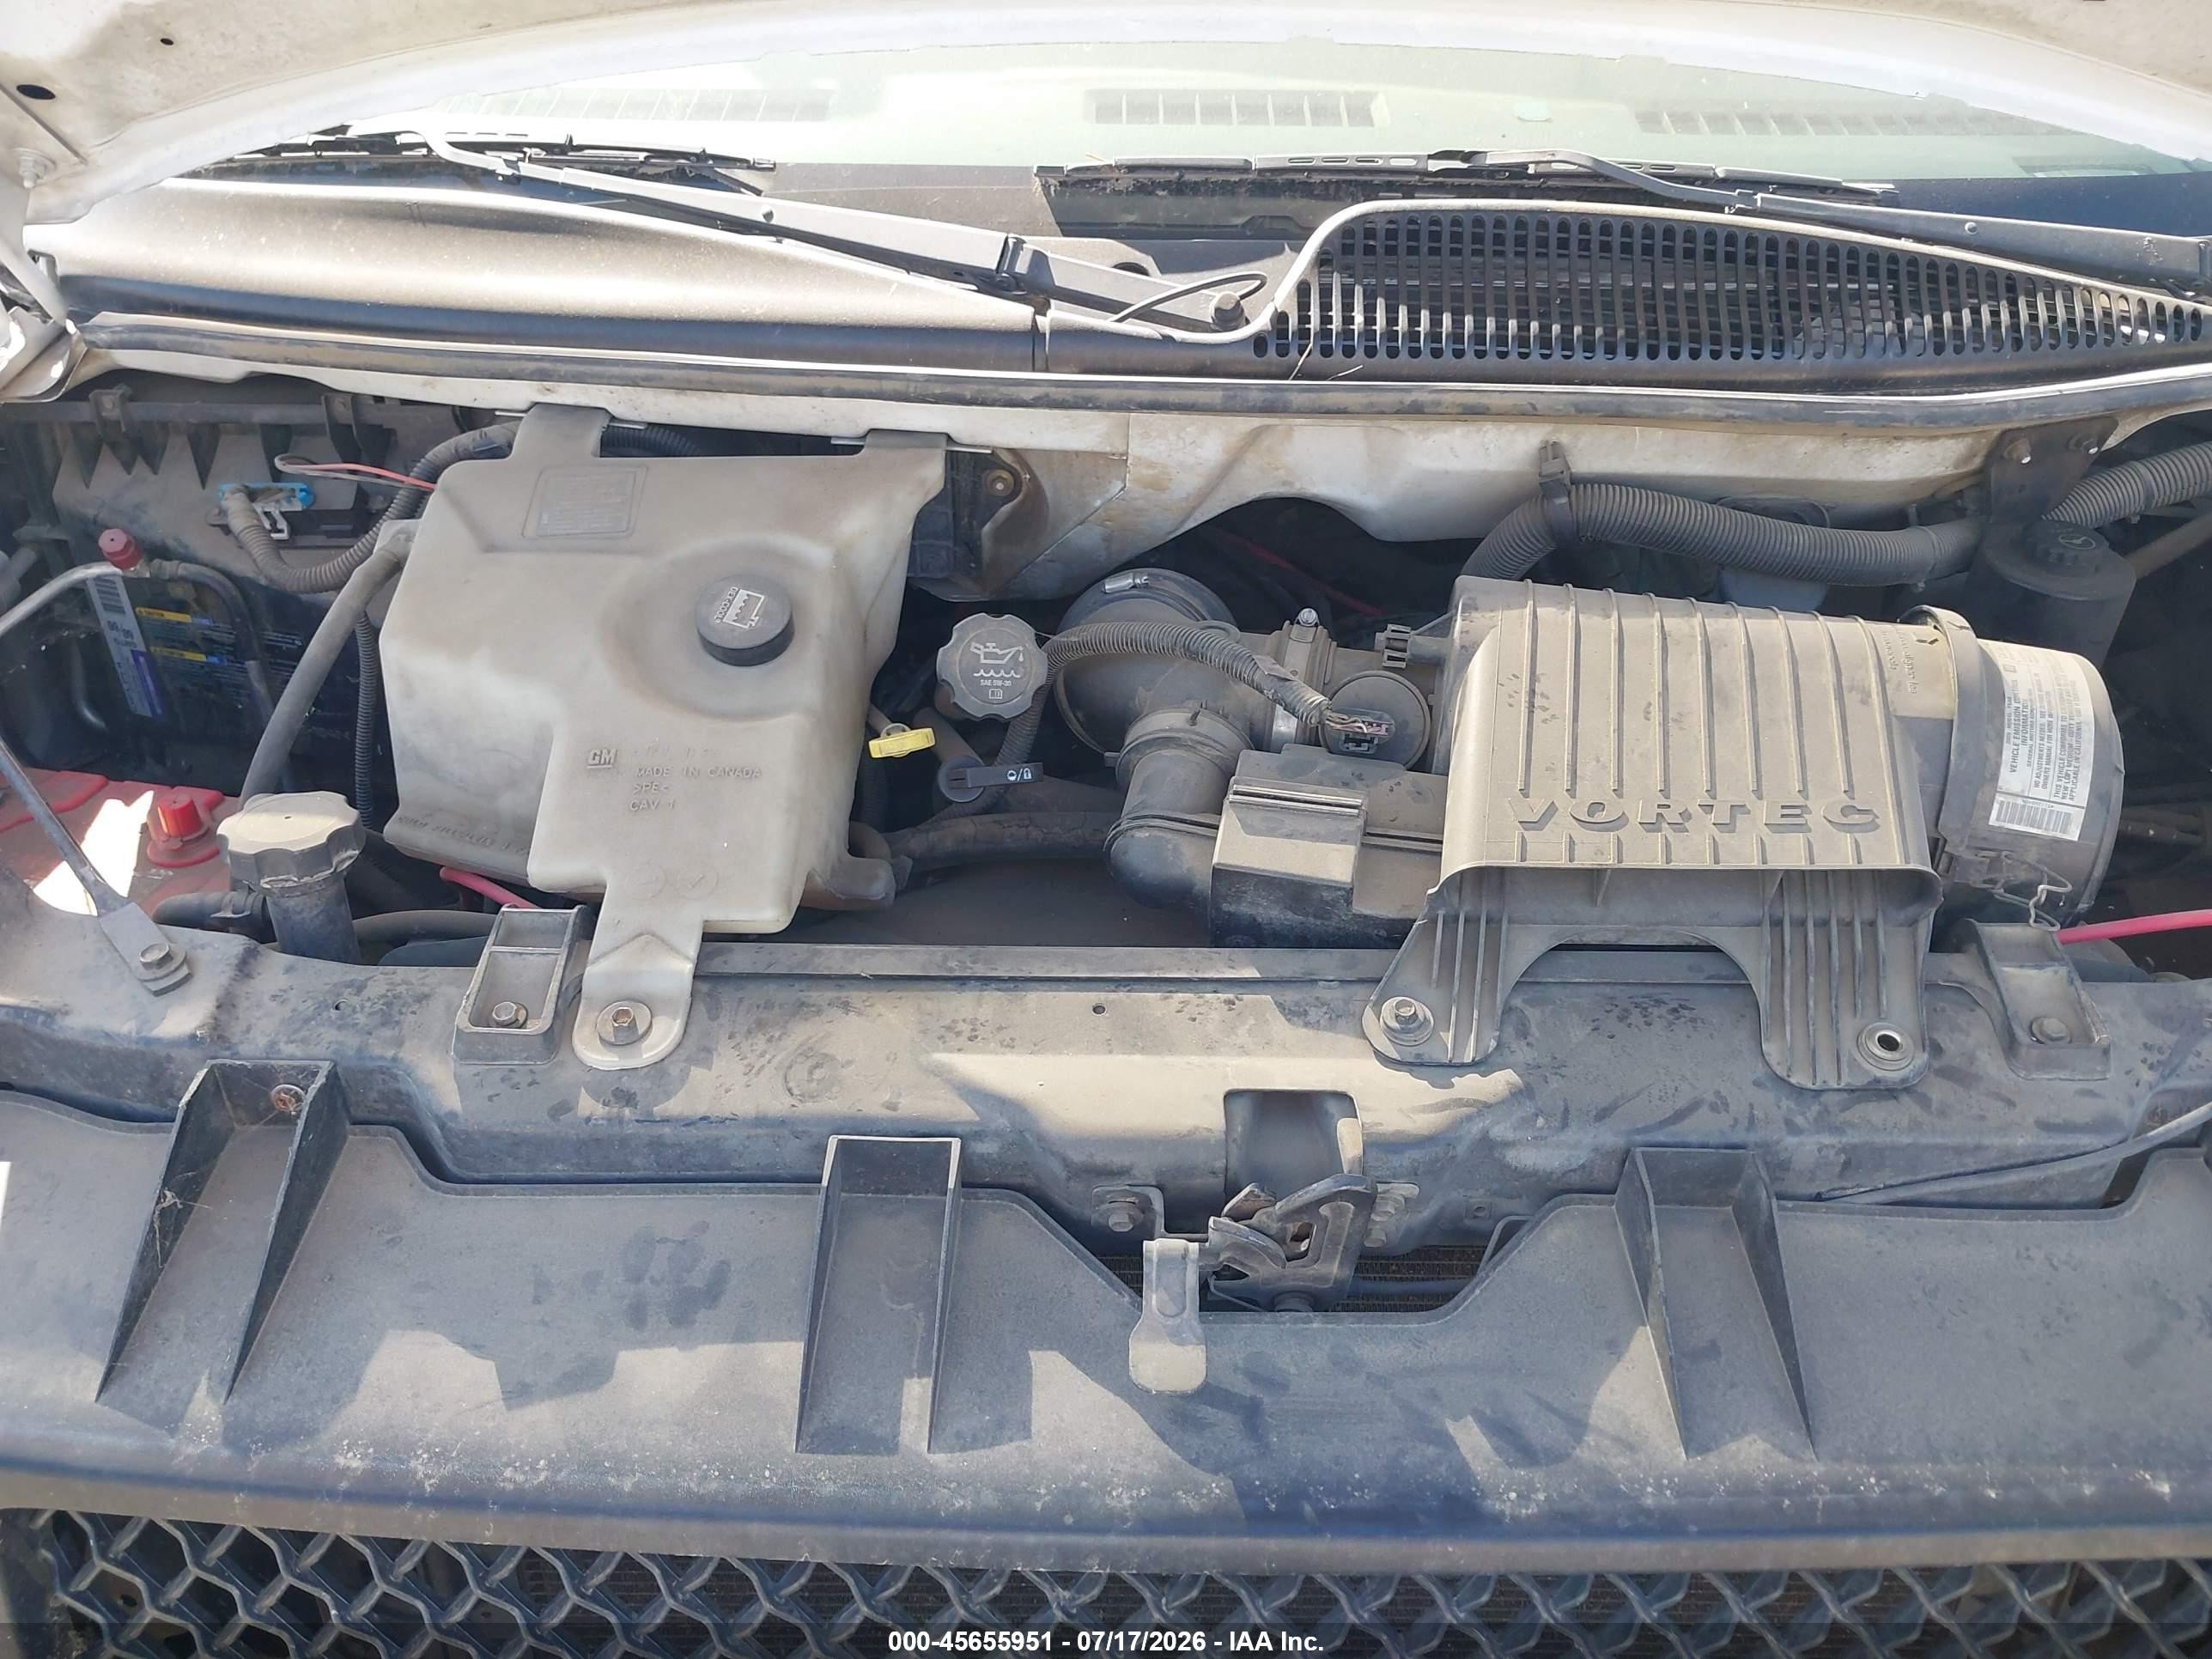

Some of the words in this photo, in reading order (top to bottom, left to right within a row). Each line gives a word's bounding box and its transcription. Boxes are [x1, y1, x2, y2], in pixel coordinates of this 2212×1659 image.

[587, 748, 617, 765] GM
[2009, 743, 2020, 773] VEHICLE
[2035, 743, 2045, 779] ADJUSTMENTS
[2057, 757, 2065, 781] VEHICLE
[635, 766, 673, 778] MADE
[682, 767, 701, 778] IN
[707, 767, 763, 779] CANADA
[2069, 764, 2080, 801] APPLICABLE
[629, 799, 660, 811] CAV
[1505, 797, 1881, 833] VORTEC
